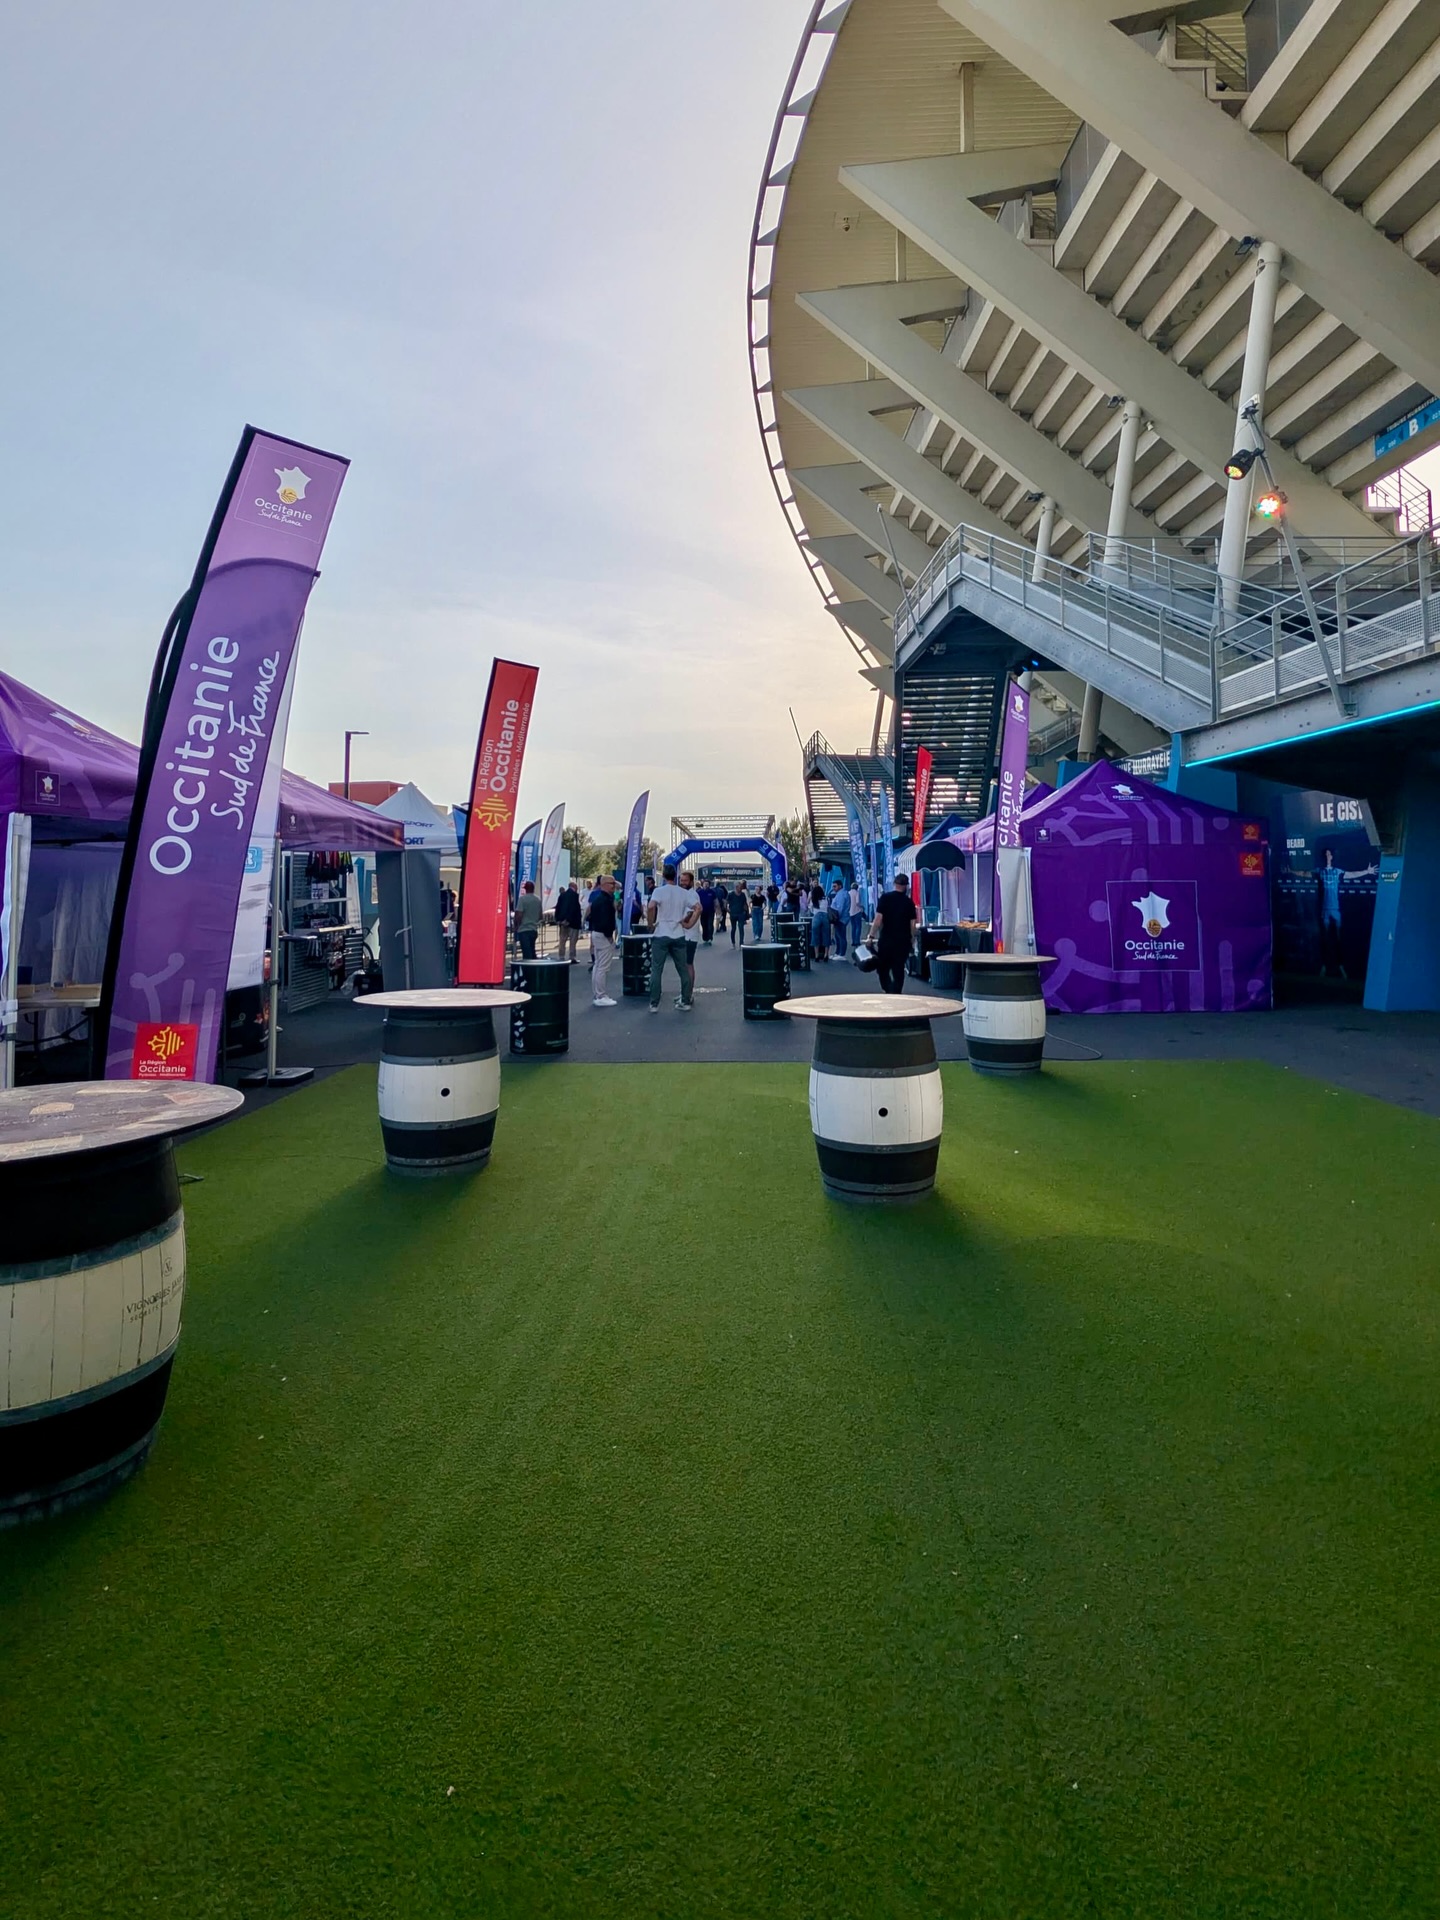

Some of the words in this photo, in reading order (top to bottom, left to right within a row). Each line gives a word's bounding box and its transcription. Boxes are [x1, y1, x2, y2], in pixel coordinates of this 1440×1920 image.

[1409, 418, 1419, 437] B
[254, 497, 313, 521] Occitanie
[258, 508, 273, 519] Sud
[280, 515, 303, 527] France
[227, 651, 280, 737] France
[489, 699, 520, 792] Occitanie
[149, 636, 240, 875] Occitanie
[229, 738, 257, 774] de
[480, 739, 495, 776] Région
[478, 778, 488, 790] La
[210, 769, 254, 830] Sud
[1320, 803, 1334, 822] LE
[703, 840, 741, 849] DÉPART
[1009, 830, 1019, 847] ud
[1124, 939, 1185, 950] Occitanie
[1132, 951, 1147, 960] Sud
[1154, 950, 1179, 960] France
[138, 1065, 187, 1073] Occitanie
[126, 1286, 171, 1313] VIGNOBLES
